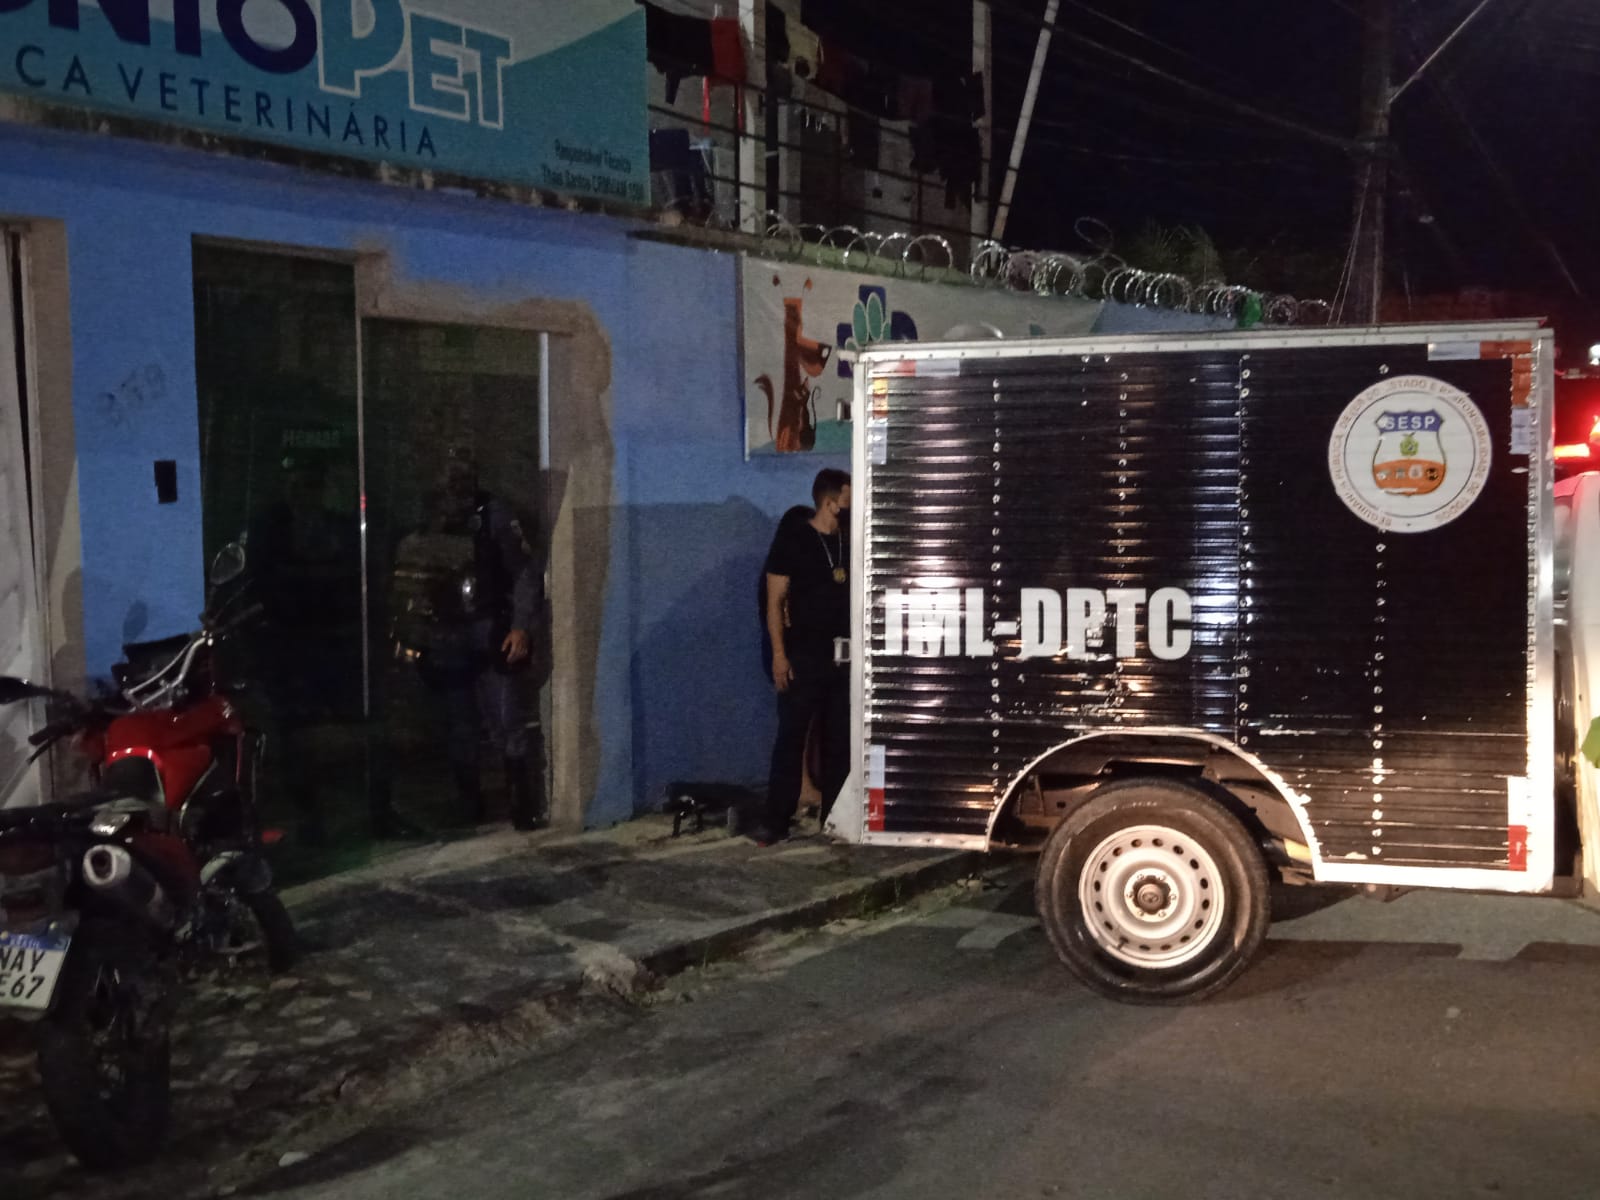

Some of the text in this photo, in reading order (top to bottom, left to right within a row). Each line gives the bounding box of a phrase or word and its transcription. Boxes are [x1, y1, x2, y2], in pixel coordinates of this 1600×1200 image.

[118, 62, 438, 158] VETERINÁRIA
[1384, 416, 1436, 430] SESP
[884, 587, 1193, 661] IML-DPTC
